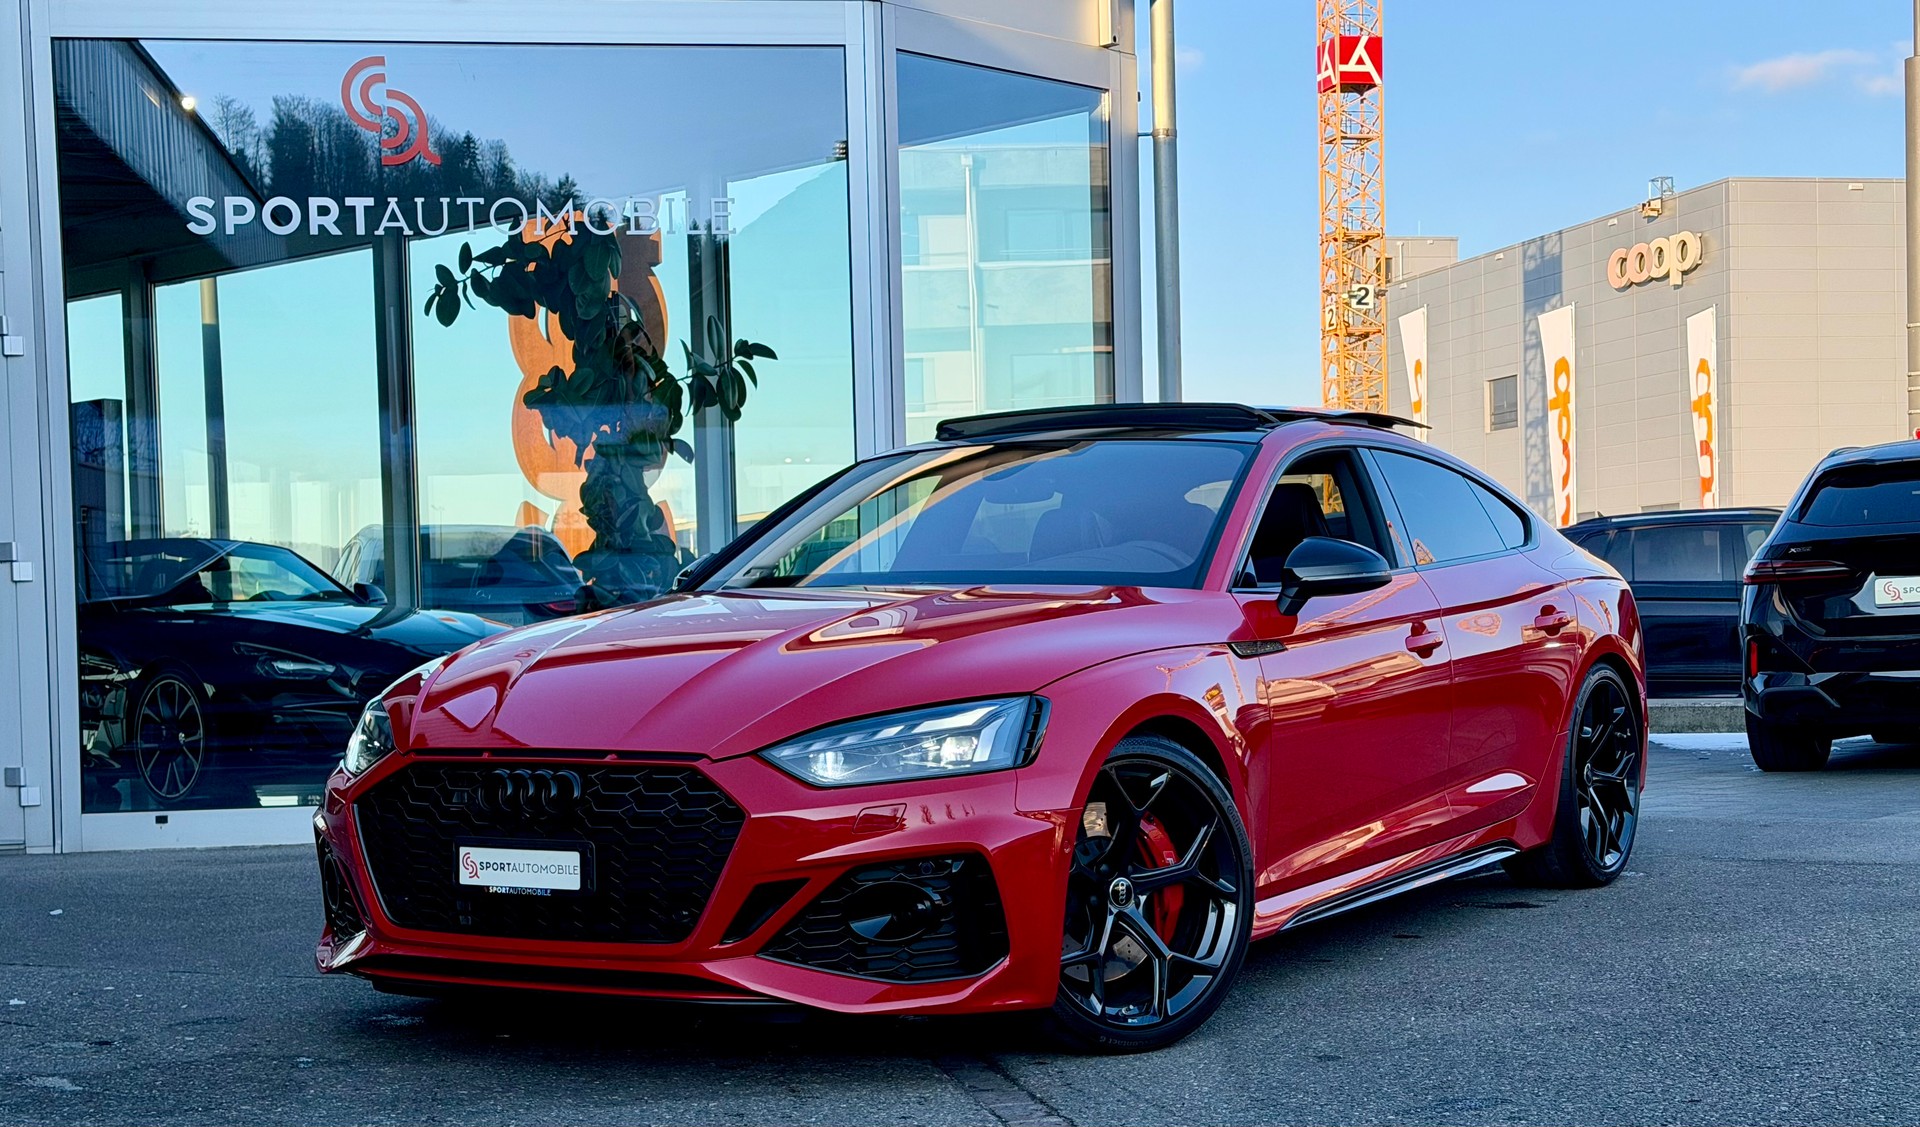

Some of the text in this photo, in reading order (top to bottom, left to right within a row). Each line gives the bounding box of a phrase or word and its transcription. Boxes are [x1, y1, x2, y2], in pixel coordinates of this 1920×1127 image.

[186, 196, 737, 236] SPORTAUTOMOBILE
[1607, 231, 1699, 289] coop
[1355, 286, 1370, 306] 2
[479, 861, 579, 876] SPORTAUTOMOBILE
[488, 886, 551, 897] SPORTAUTOMOBILE
